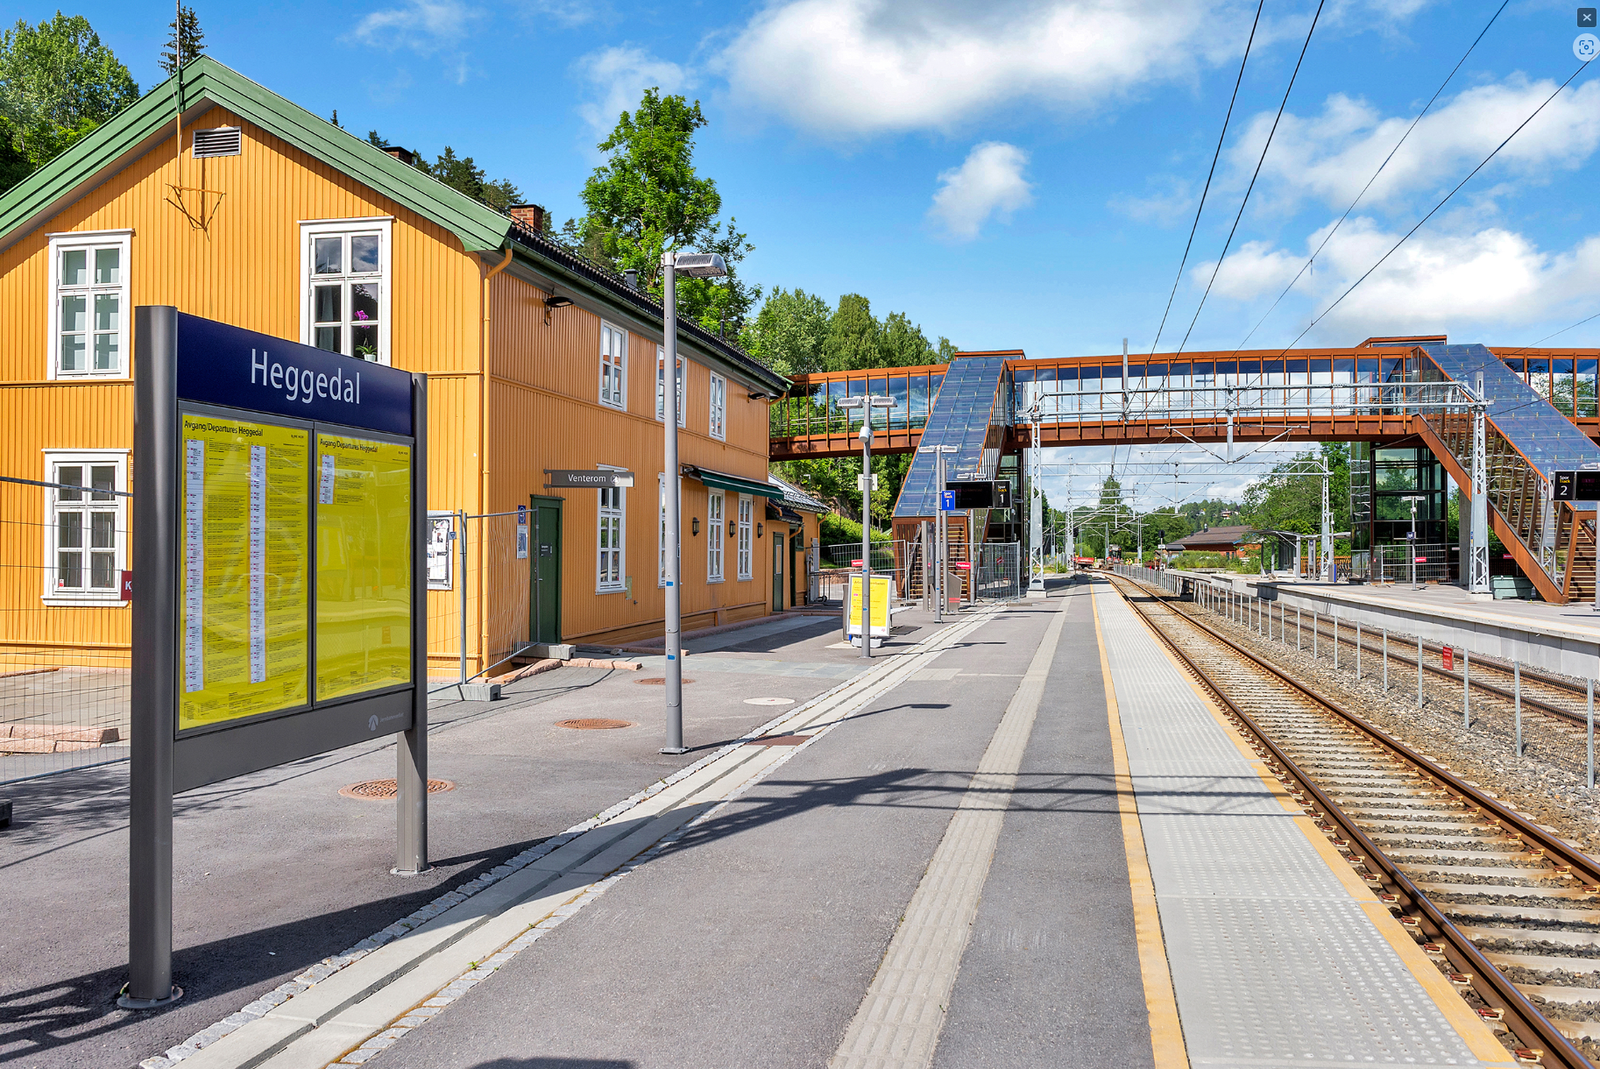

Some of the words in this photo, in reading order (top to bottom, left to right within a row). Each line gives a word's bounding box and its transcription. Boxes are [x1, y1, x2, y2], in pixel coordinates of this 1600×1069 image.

[251, 348, 360, 404] Heggedal
[238, 426, 263, 437] Heggedal
[567, 474, 607, 482] Venterom
[1560, 485, 1568, 496] 2
[946, 499, 950, 508] 1
[1000, 494, 1004, 503] 1
[125, 581, 133, 592] K
